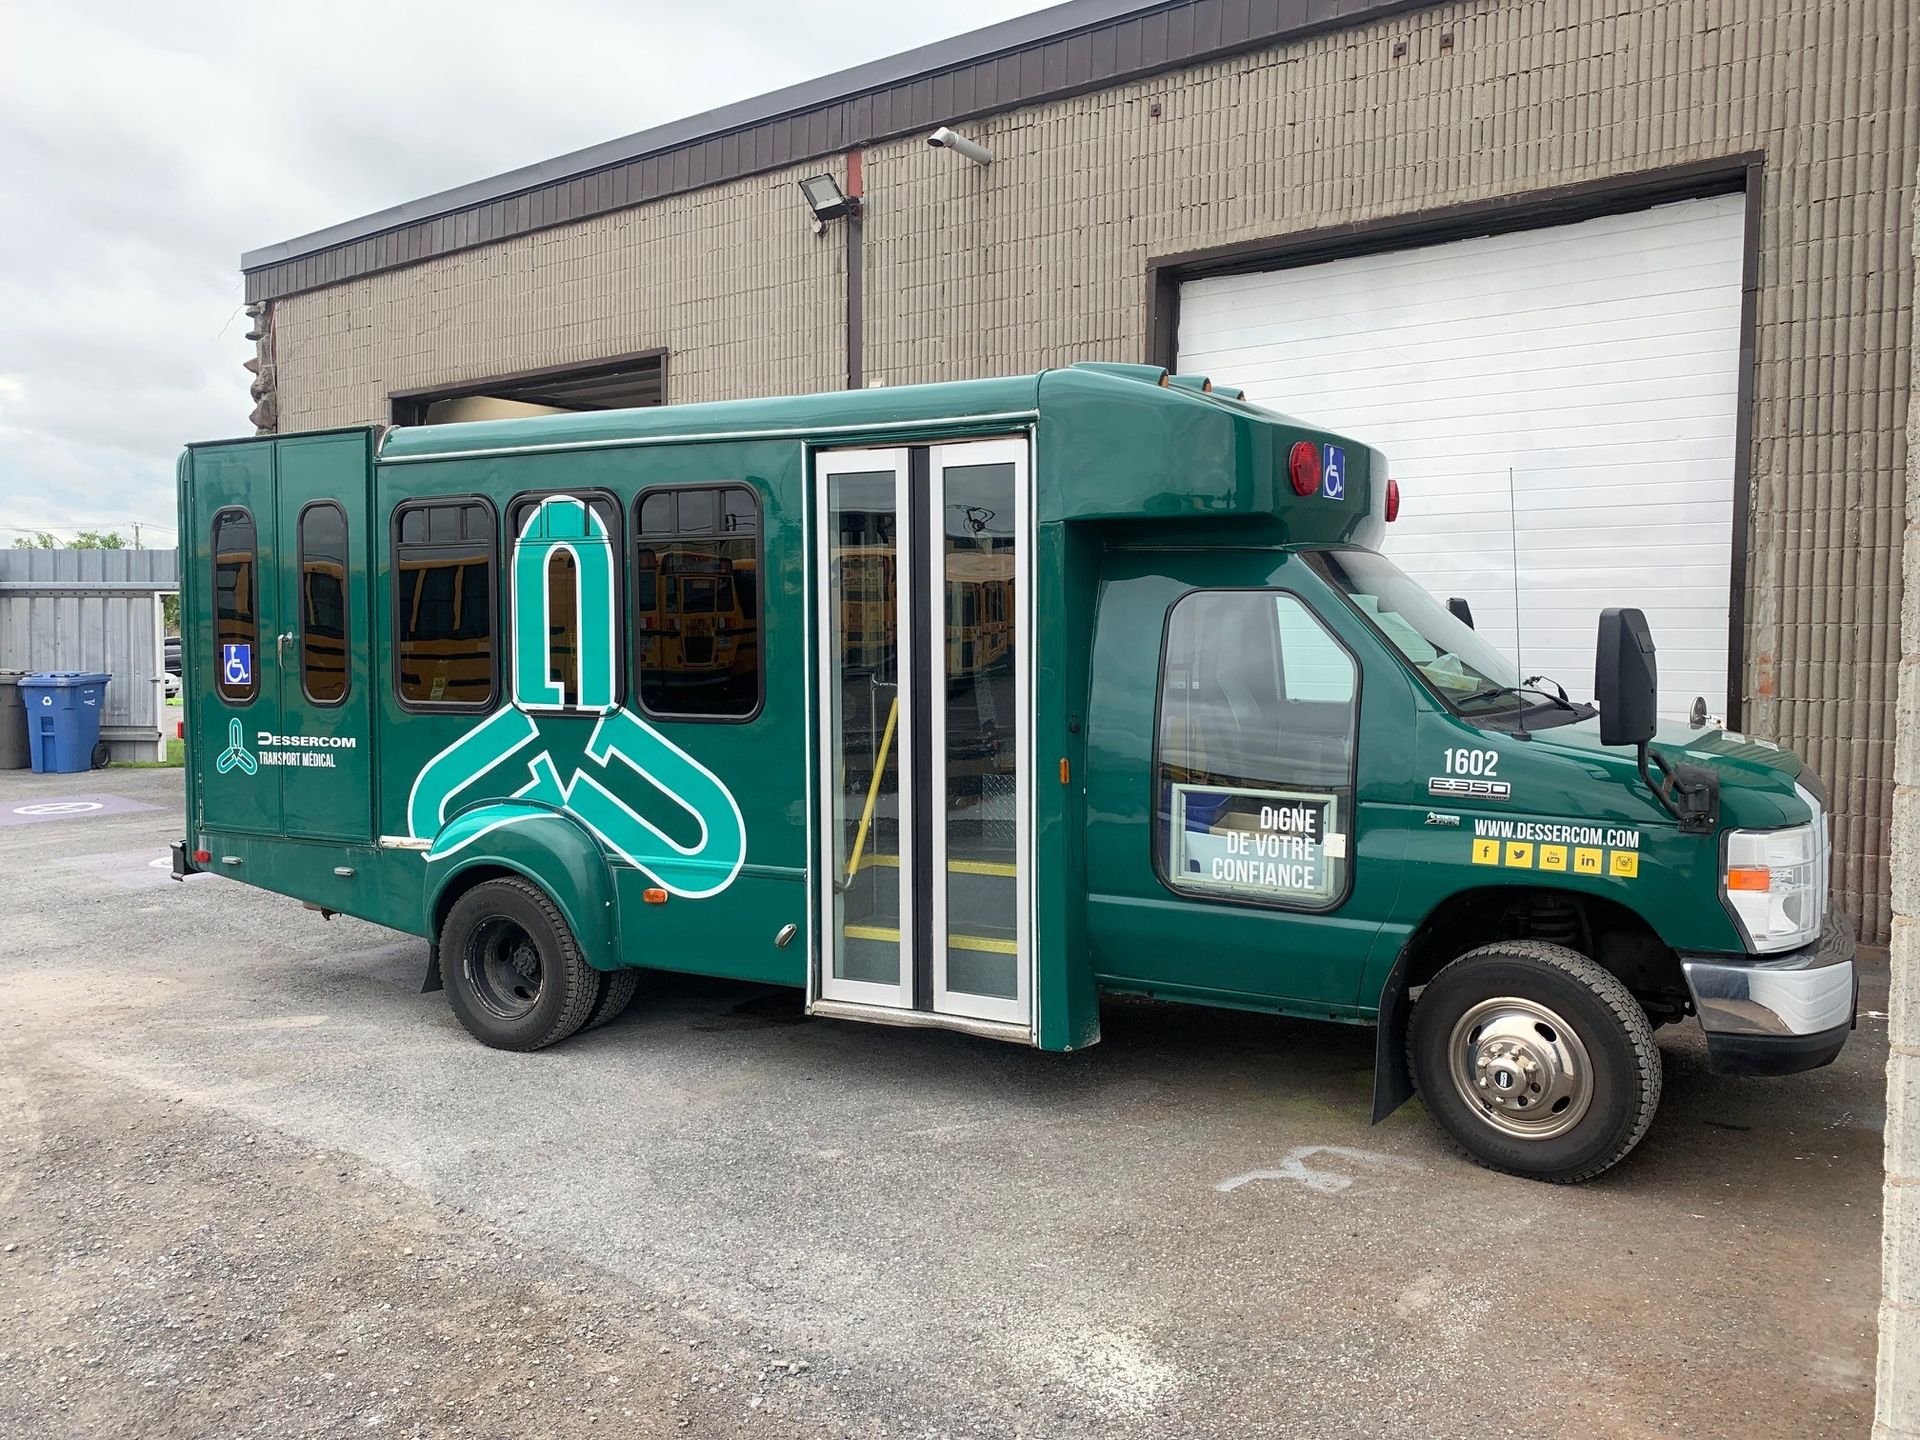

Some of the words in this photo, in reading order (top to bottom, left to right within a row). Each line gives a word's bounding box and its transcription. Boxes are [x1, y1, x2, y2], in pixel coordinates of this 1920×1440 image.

[257, 731, 357, 748] DESSERCOM
[258, 751, 300, 767] TRANSPORT
[302, 750, 336, 768] MÉDICAL
[1444, 748, 1499, 777] 1602
[1430, 779, 1508, 795] E-350
[1474, 818, 1640, 848] WWW.DESSERCOM.COM
[1226, 832, 1250, 856] DE
[1254, 833, 1316, 862] VOTRE
[1581, 854, 1595, 867] in
[1212, 857, 1315, 890] CONFIANCE
